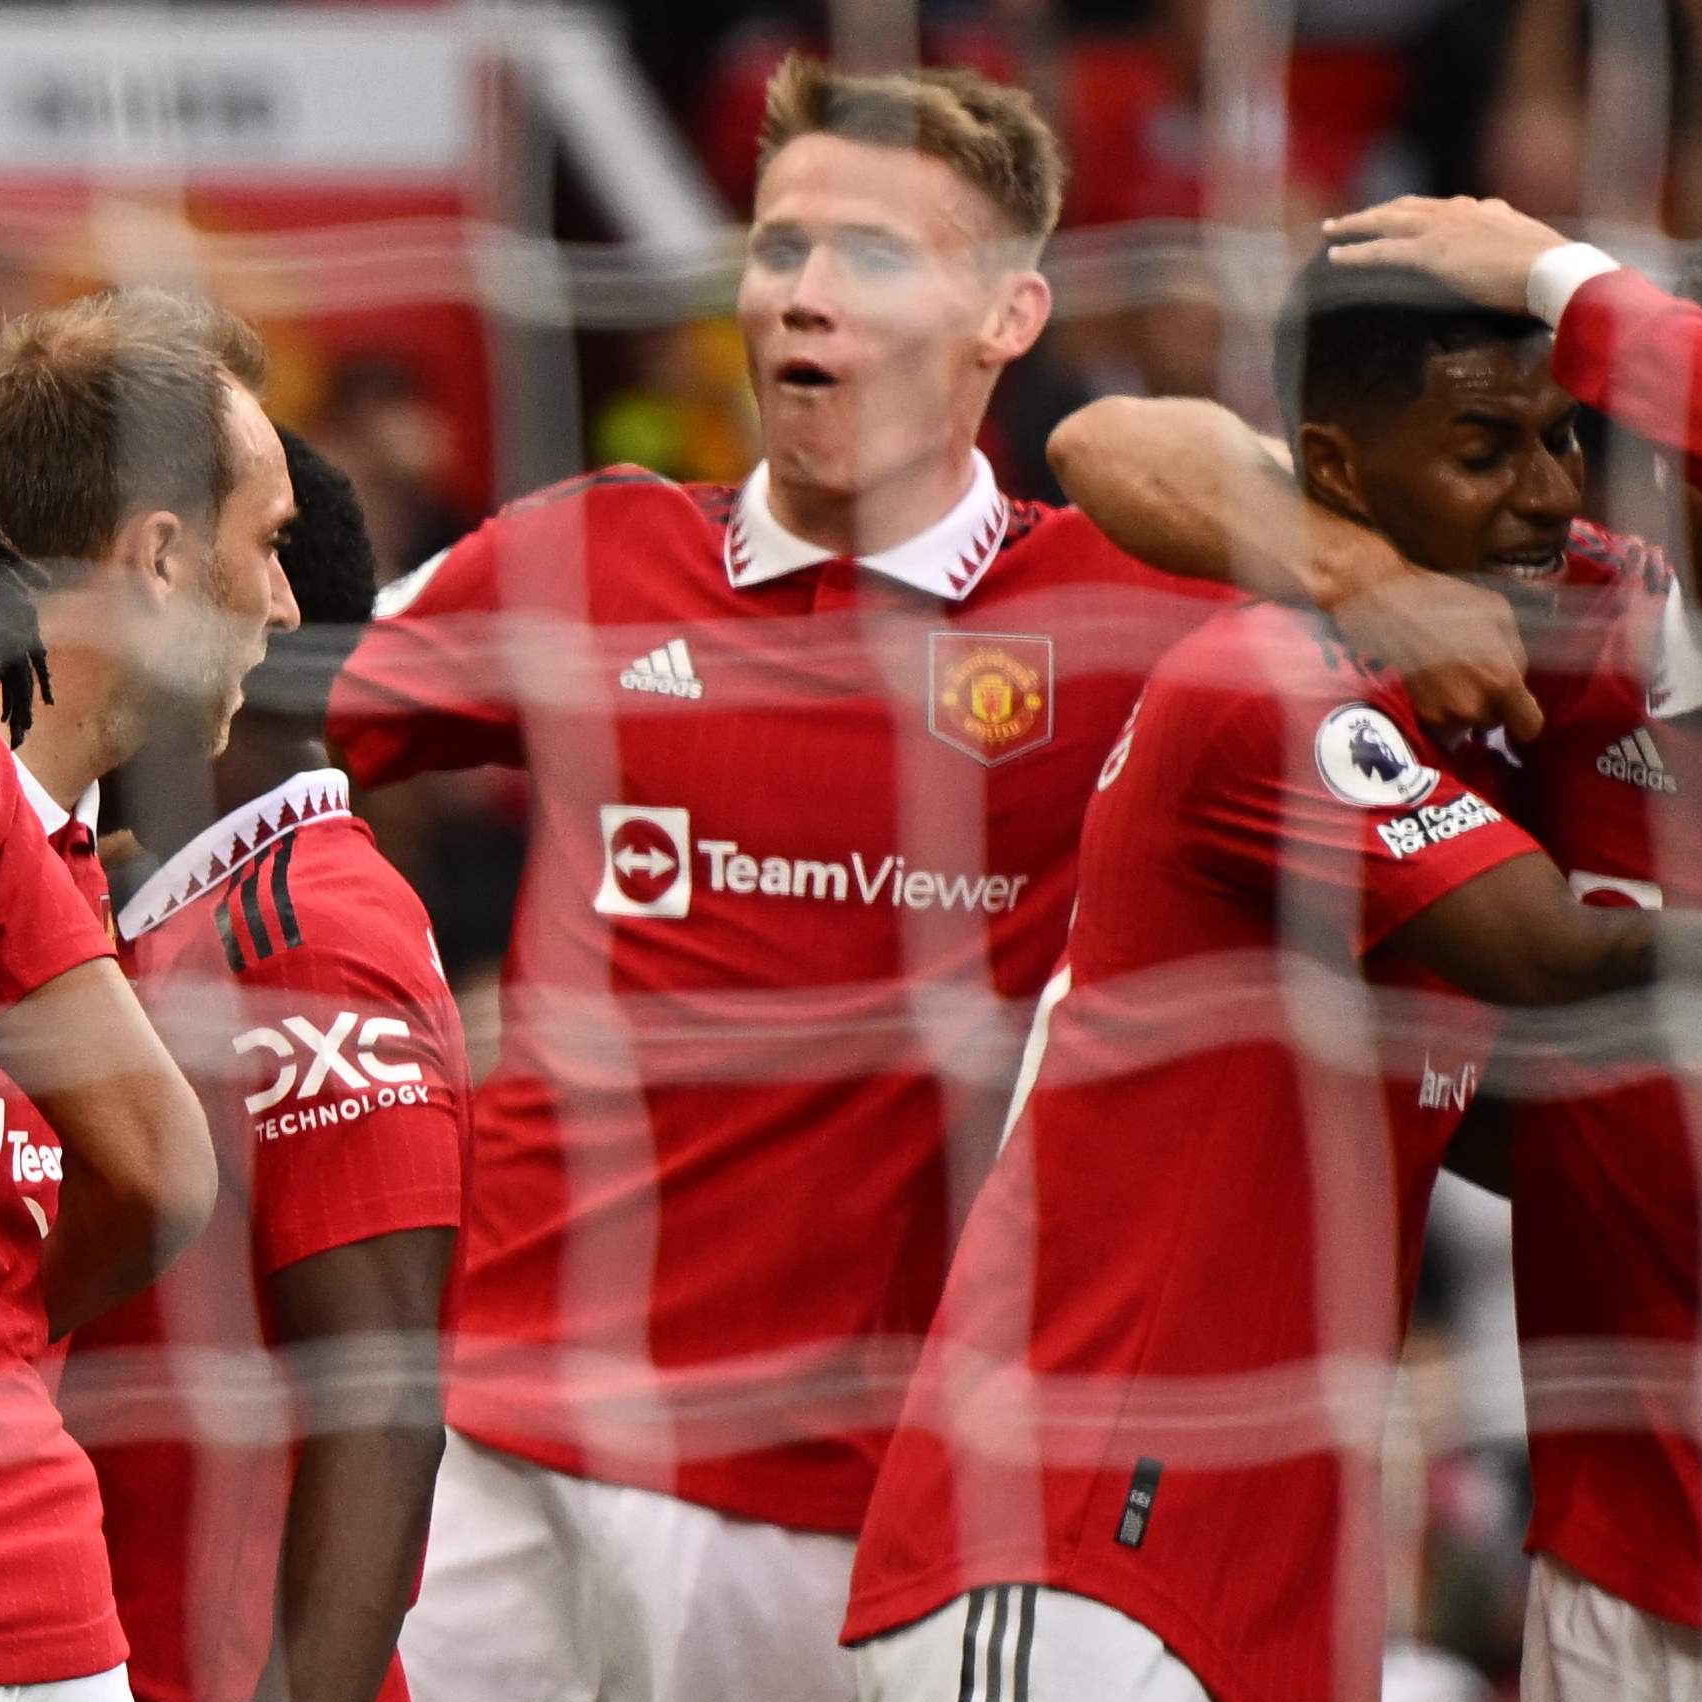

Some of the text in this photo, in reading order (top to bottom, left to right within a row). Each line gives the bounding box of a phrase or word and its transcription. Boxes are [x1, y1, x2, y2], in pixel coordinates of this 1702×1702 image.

[1595, 755, 1678, 794] adidas
[697, 839, 1029, 914] TeamViewer
[231, 1011, 423, 1115] DXC
[255, 1084, 430, 1143] TECHNOLOGY
